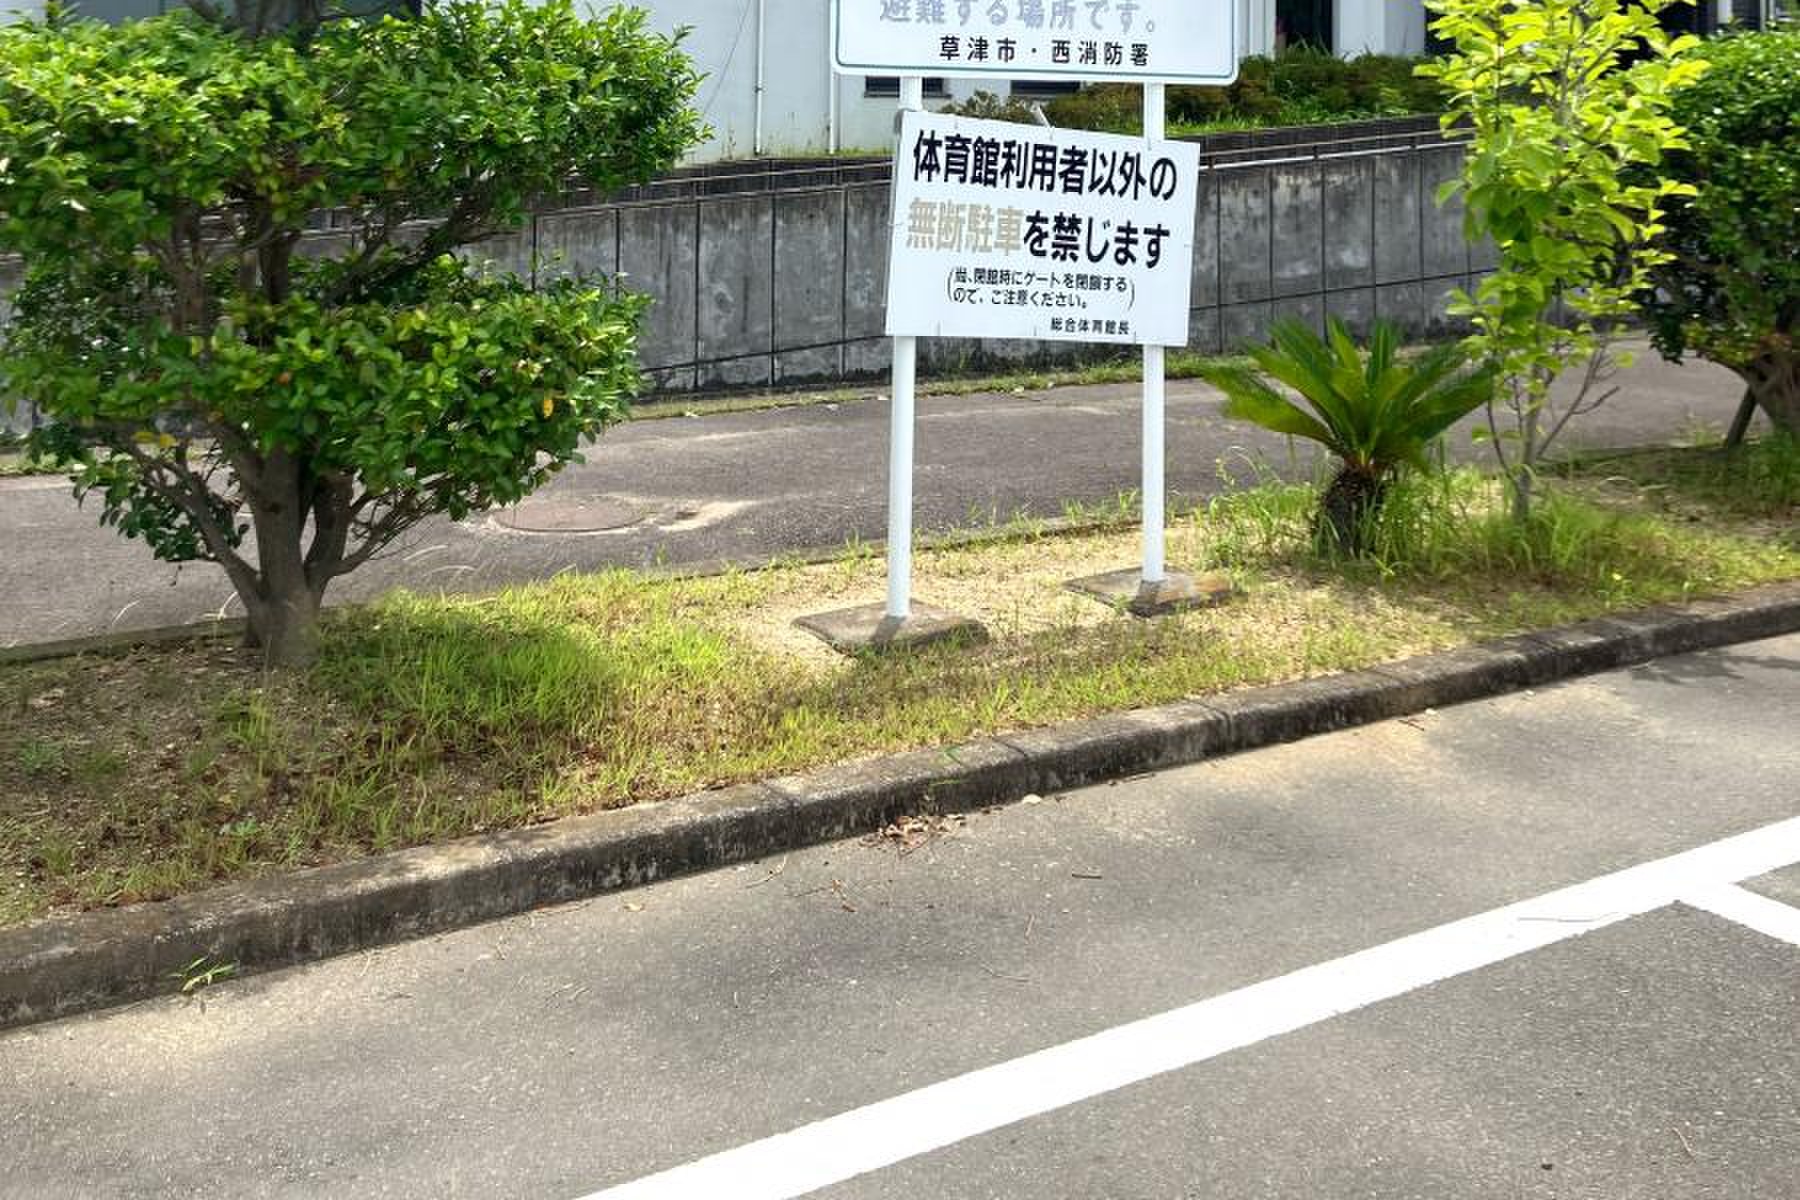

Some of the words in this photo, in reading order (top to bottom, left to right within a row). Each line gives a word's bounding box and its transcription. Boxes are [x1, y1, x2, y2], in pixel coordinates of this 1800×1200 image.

[939, 36, 1150, 67] 草津市・西消防署
[913, 129, 1177, 201] 体育館利用者以外の
[906, 197, 1171, 269] 無断駐車を禁じます
